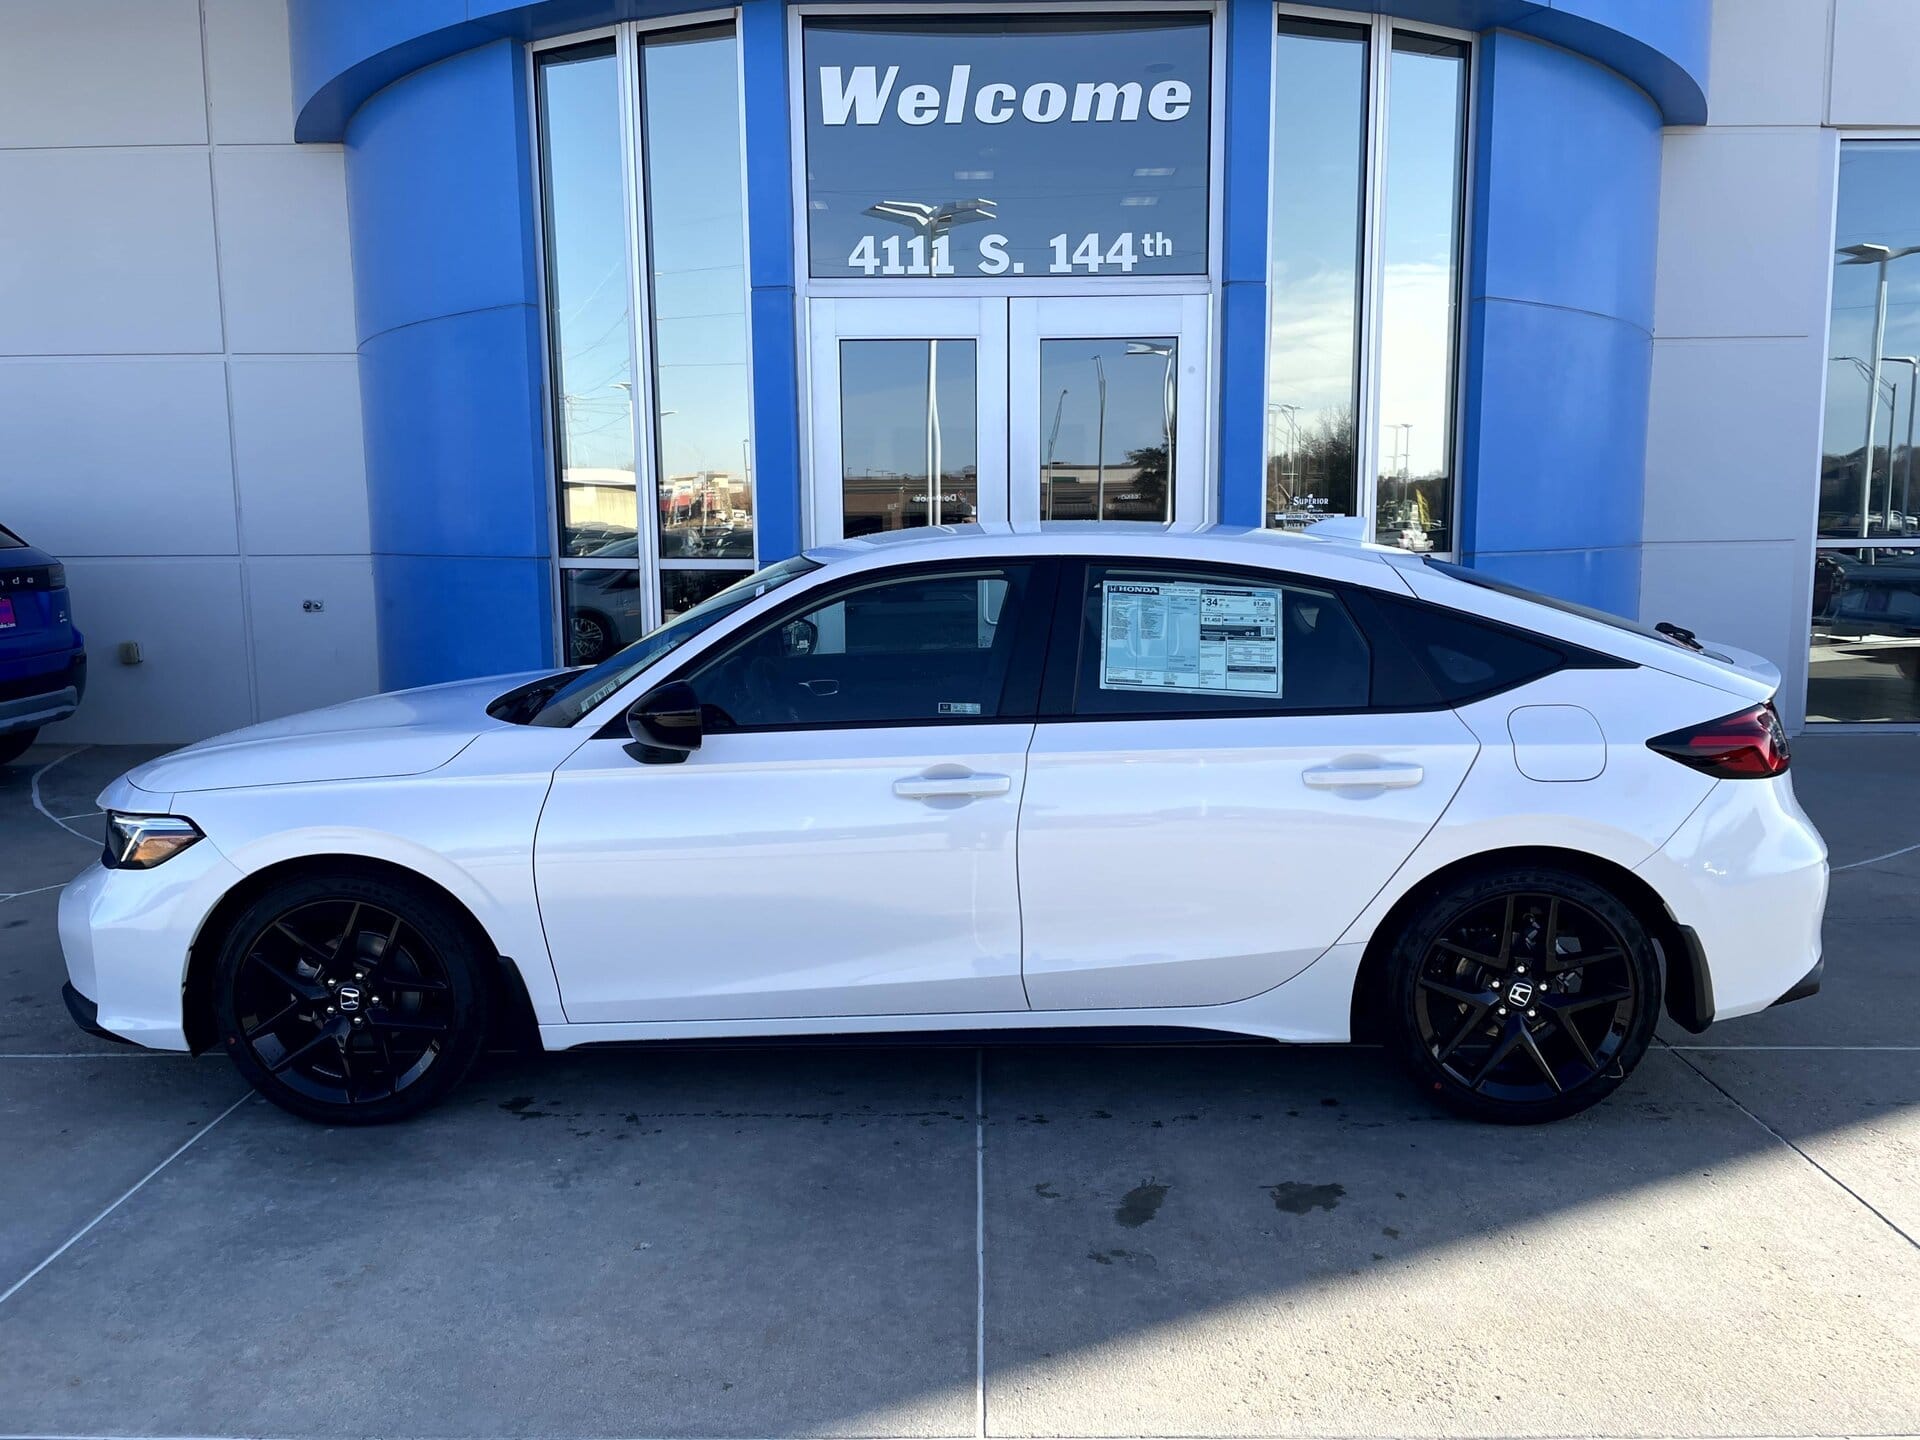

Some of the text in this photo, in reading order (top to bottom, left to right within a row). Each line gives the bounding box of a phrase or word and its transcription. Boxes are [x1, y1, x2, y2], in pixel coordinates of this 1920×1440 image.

[819, 65, 1192, 126] Welcome
[848, 235, 955, 275] 4111
[977, 234, 1024, 274] S.
[1119, 585, 1158, 594] HONDA
[1206, 598, 1218, 607] 34
